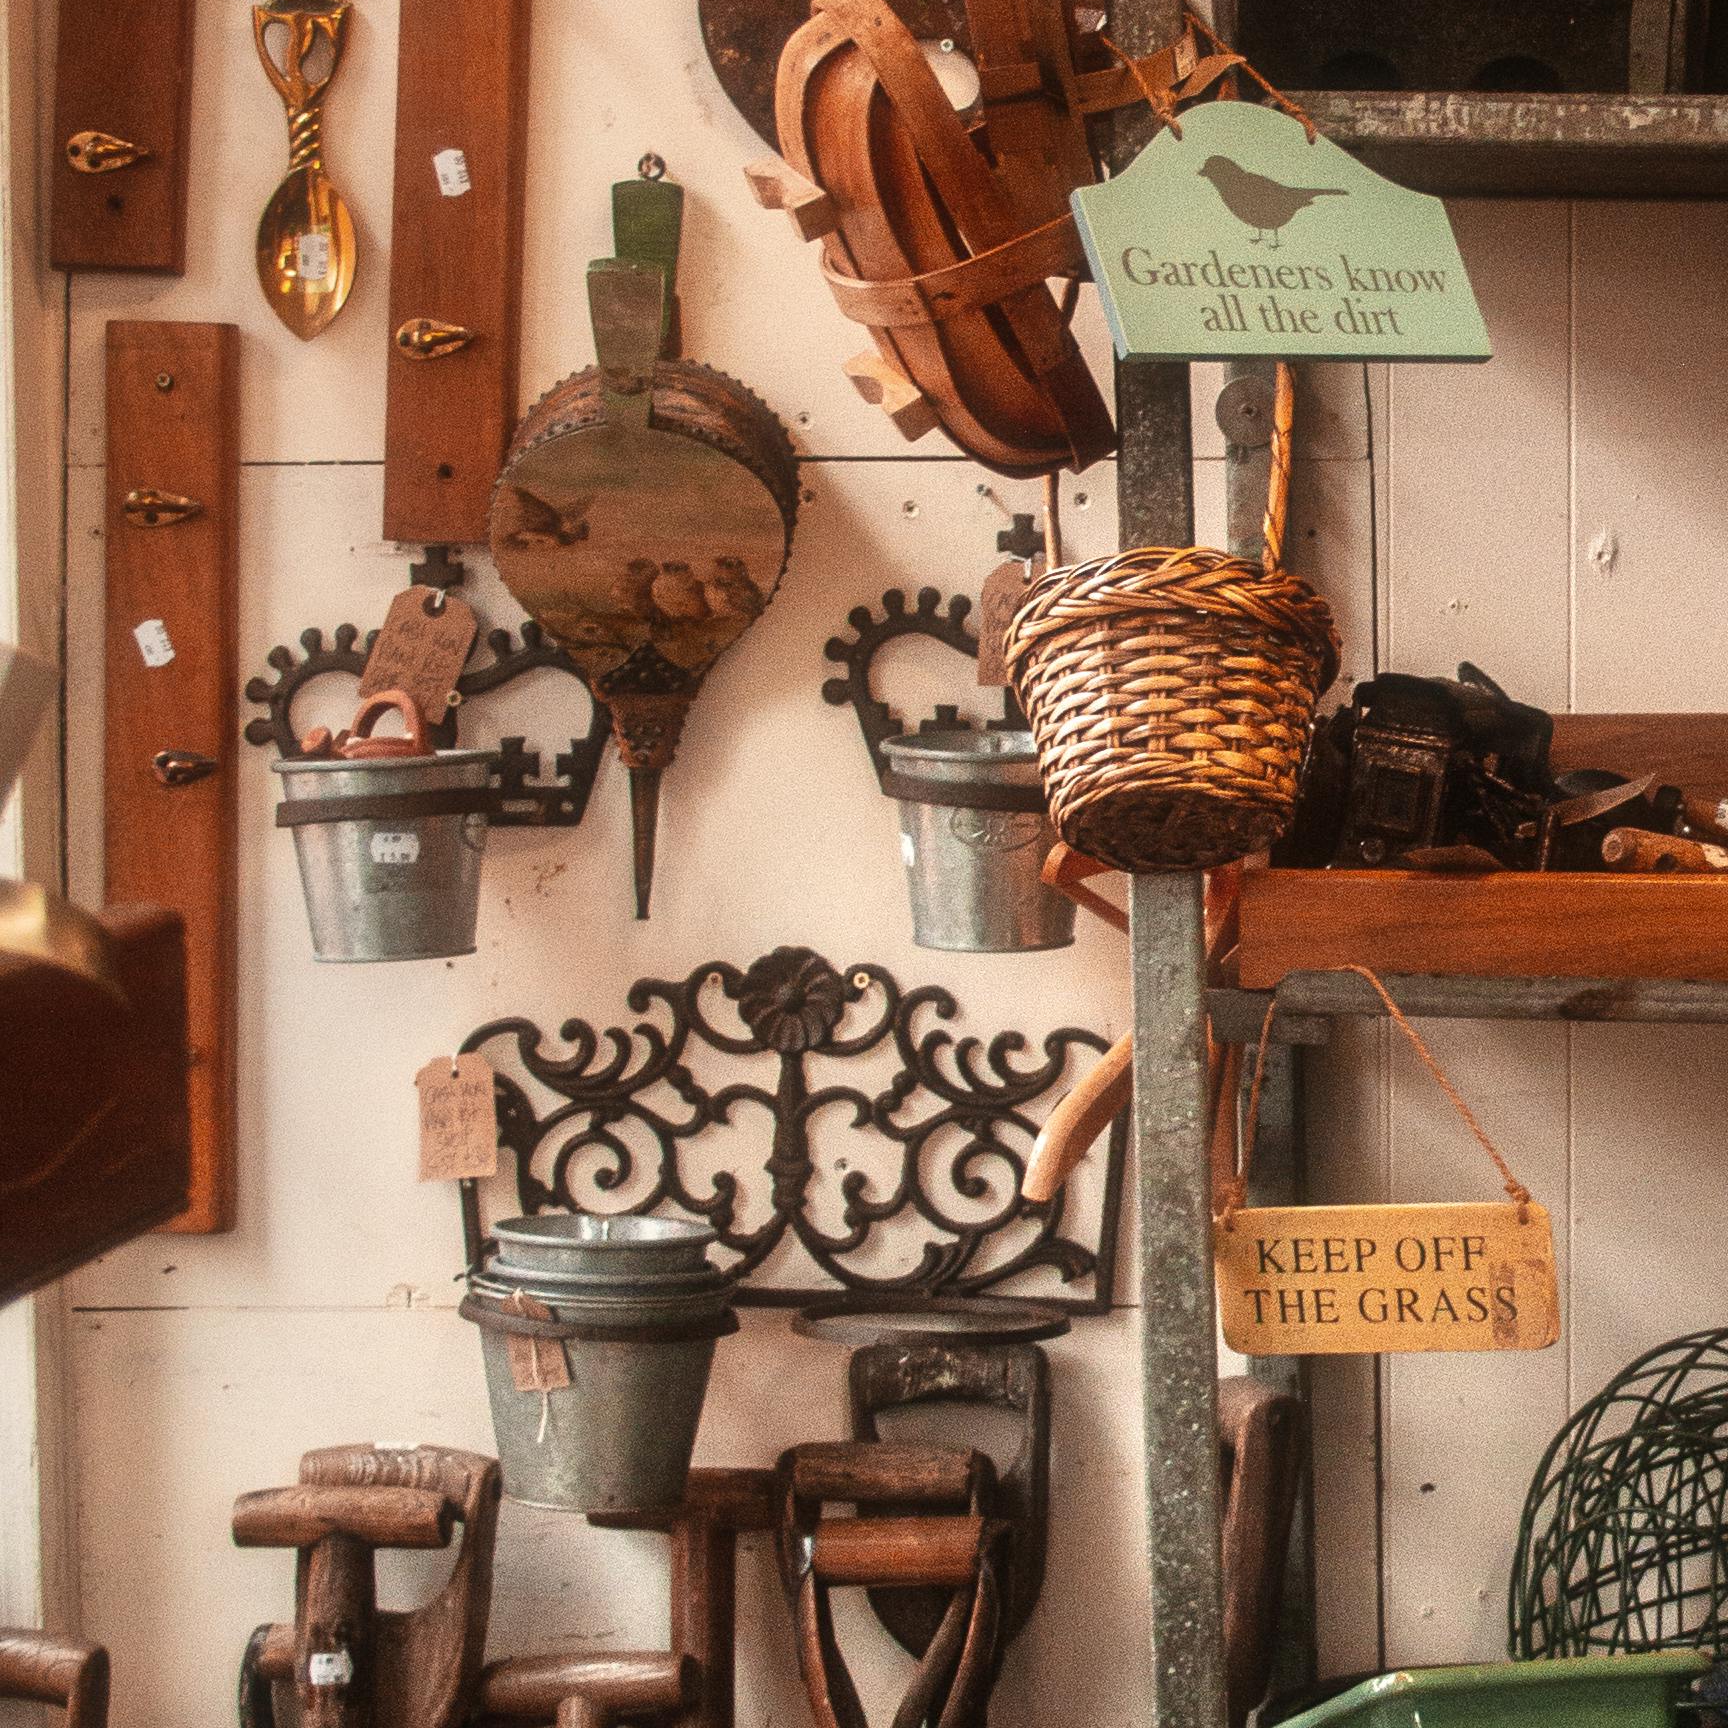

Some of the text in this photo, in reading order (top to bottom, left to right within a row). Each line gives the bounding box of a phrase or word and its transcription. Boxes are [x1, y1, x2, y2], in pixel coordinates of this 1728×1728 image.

[1121, 246, 1448, 294] Gardeners know
[1200, 294, 1405, 336] all the dirt
[1255, 1235, 1488, 1273] KEEP OFF
[1243, 1286, 1520, 1324] THE GRASS
